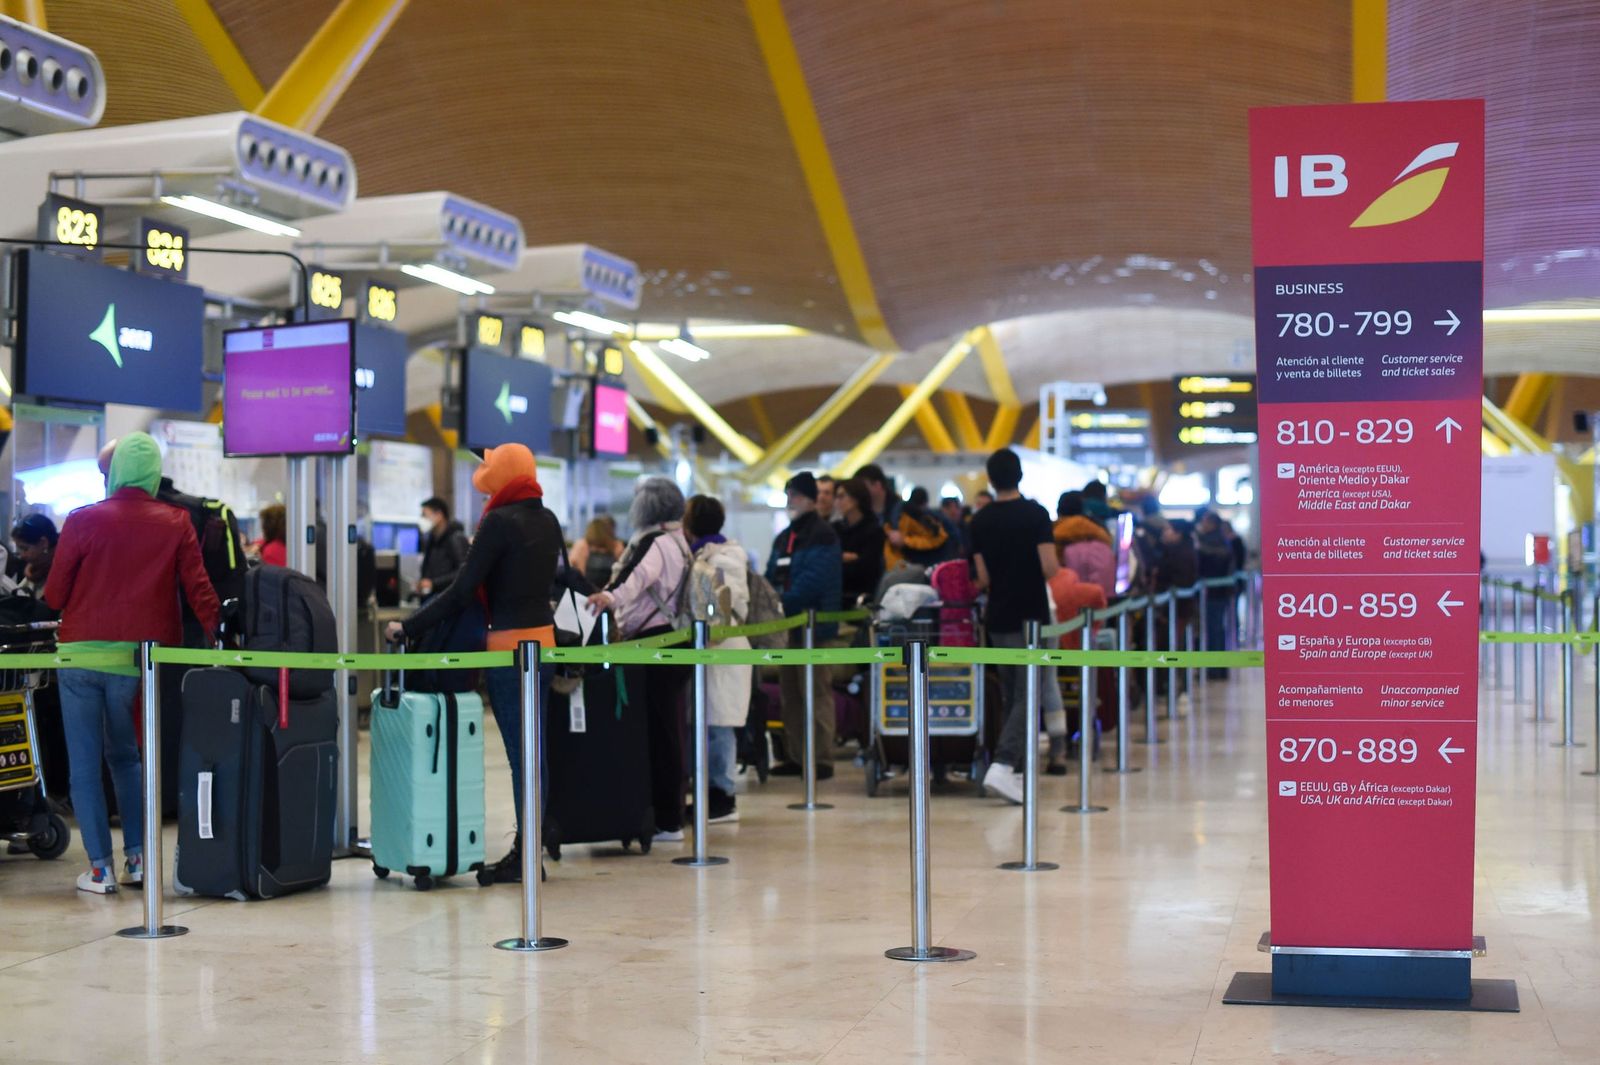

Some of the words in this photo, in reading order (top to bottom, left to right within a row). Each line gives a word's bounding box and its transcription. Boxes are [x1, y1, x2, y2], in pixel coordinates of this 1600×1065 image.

[1273, 154, 1349, 198] IB
[57, 206, 98, 250] 823
[1276, 283, 1343, 296] BUSINESS
[1276, 356, 1318, 367] Atención
[1321, 356, 1329, 366] al
[1332, 356, 1364, 366] cliente
[1382, 355, 1428, 365] Customer
[1430, 354, 1464, 364] service
[1276, 372, 1282, 382] y
[1284, 370, 1310, 379] venta
[1313, 369, 1324, 379] de
[1327, 368, 1361, 378] billetes
[1382, 367, 1400, 377] and
[1403, 367, 1429, 377] ticket
[1431, 366, 1455, 376] sales
[1299, 464, 1339, 474] América
[1342, 466, 1375, 475] (excepto
[1299, 476, 1335, 486] Oriente
[1339, 475, 1369, 485] Medio
[1372, 477, 1377, 487] y
[1380, 474, 1409, 485] Dakar
[1298, 489, 1339, 499] America
[1343, 491, 1369, 500] (except
[1298, 500, 1332, 511] Middle
[1335, 500, 1356, 510] East
[1359, 500, 1378, 510] and
[1380, 499, 1411, 510] Dakar
[1278, 537, 1320, 547] Atención
[1322, 537, 1330, 547] al
[1333, 537, 1365, 547] cliente
[1384, 537, 1430, 547] Customer
[1432, 537, 1464, 546] service
[1278, 553, 1283, 562] y
[1285, 551, 1312, 560] venta
[1314, 550, 1326, 560] de
[1328, 550, 1363, 560] billetes
[1383, 550, 1401, 559] and
[1404, 549, 1430, 559] ticket
[1433, 549, 1457, 559] sales
[1300, 636, 1334, 648] España
[1337, 638, 1343, 648] y
[1346, 636, 1380, 649] Europa
[1383, 638, 1415, 648] (excepto
[1418, 638, 1432, 647] GB)
[1299, 649, 1327, 660] Spain
[1330, 648, 1349, 659] and
[1351, 649, 1386, 661] Europe
[1389, 650, 1416, 660] (except
[1419, 650, 1432, 659] UK)
[1279, 685, 1363, 697] Acompañamiento
[1381, 685, 1459, 697] Unaccompanied
[1279, 698, 1290, 707] de
[1293, 699, 1333, 708] menores
[1381, 699, 1409, 708] minor
[1411, 698, 1444, 708] service
[1301, 782, 1330, 793] EEUU,
[1333, 782, 1348, 793] GB
[1350, 785, 1356, 795] y
[1359, 780, 1388, 793] África
[1391, 785, 1424, 795] (excepto
[1426, 785, 1450, 794] Dakar)
[1301, 795, 1323, 806] USA,
[1327, 795, 1341, 805] UK
[1343, 795, 1362, 806] and
[1364, 795, 1395, 806] Africa
[1397, 798, 1426, 808] (except
[1427, 798, 1452, 807] Dakar)
